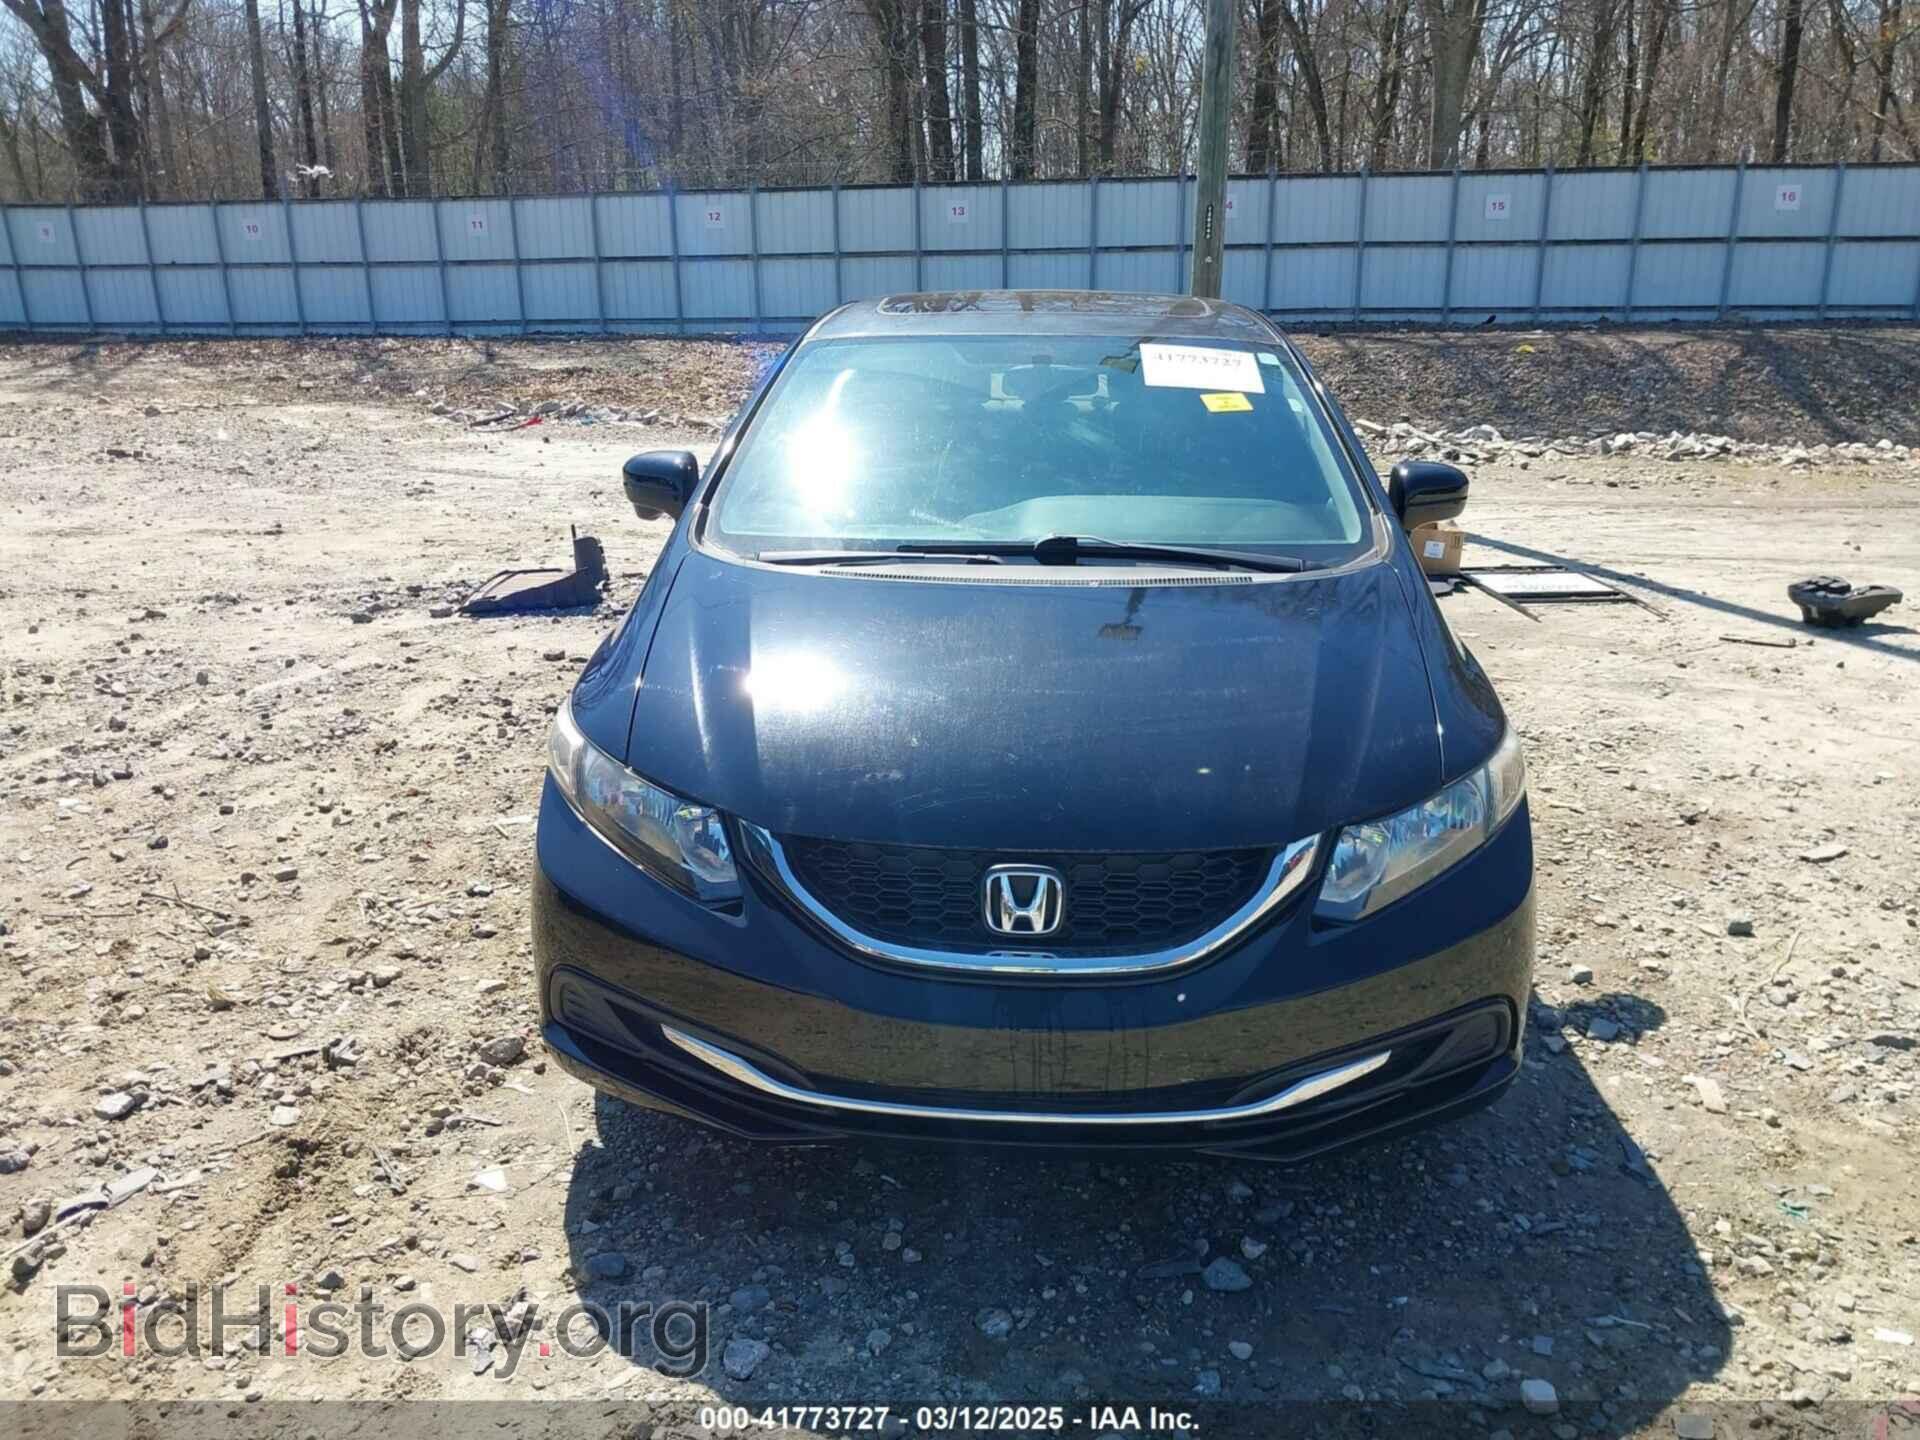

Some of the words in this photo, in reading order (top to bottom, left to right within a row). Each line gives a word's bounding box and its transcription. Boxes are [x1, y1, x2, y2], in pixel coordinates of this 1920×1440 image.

[1782, 191, 1796, 202] 16
[951, 206, 965, 216] 13
[1492, 201, 1505, 211] 15
[708, 212, 721, 221] 12
[246, 224, 258, 234] 10
[471, 220, 483, 230] 11
